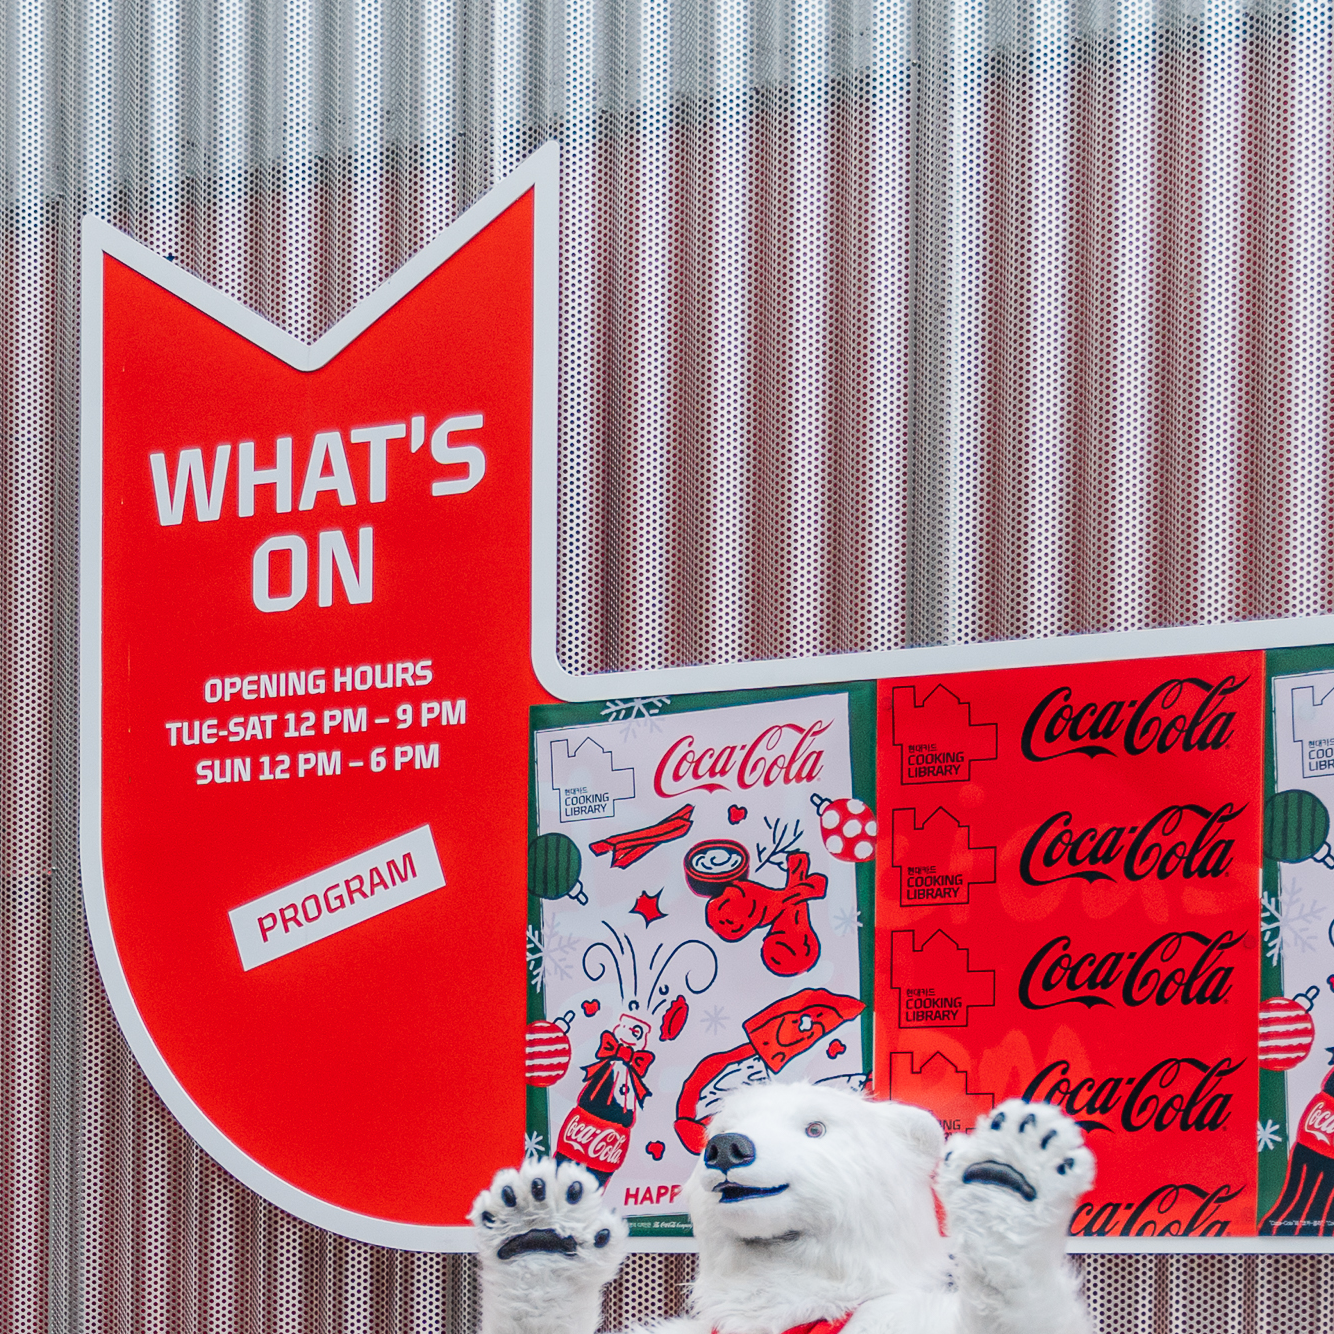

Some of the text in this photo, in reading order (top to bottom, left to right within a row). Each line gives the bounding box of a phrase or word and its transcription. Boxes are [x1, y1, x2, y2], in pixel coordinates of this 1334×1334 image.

[150, 414, 487, 527] WHAT'S
[253, 527, 374, 613] ON
[204, 661, 433, 703] OPENING HOURS
[166, 715, 277, 748] TUE-SAT
[285, 711, 316, 741] 12
[323, 706, 368, 735] PM
[397, 704, 414, 729] 9
[421, 699, 467, 727] PM
[1020, 675, 1251, 762] Coca-Cola
[196, 757, 252, 786] SUN
[260, 754, 291, 781] 12
[298, 750, 343, 778] PM
[370, 747, 386, 773] 6
[394, 744, 441, 771] PM
[653, 717, 835, 799] Coca-Cola
[908, 751, 965, 766] COOKING
[908, 764, 961, 779] LIBRARY
[564, 792, 610, 807] COOKING
[565, 804, 607, 818] LIBRARY
[1019, 801, 1250, 886] Coca-Cola
[257, 851, 418, 944] PROGRAM
[907, 874, 963, 888] COOKING
[907, 886, 959, 900] LIBRARY
[1018, 929, 1249, 1010] Coca-Cola
[906, 997, 962, 1010] COOKING
[906, 1009, 959, 1022] LIBRARY
[1021, 1056, 1248, 1134] Coca-Cola
[563, 1115, 627, 1164] Coca-Cola
[624, 1184, 683, 1206] HAPP
